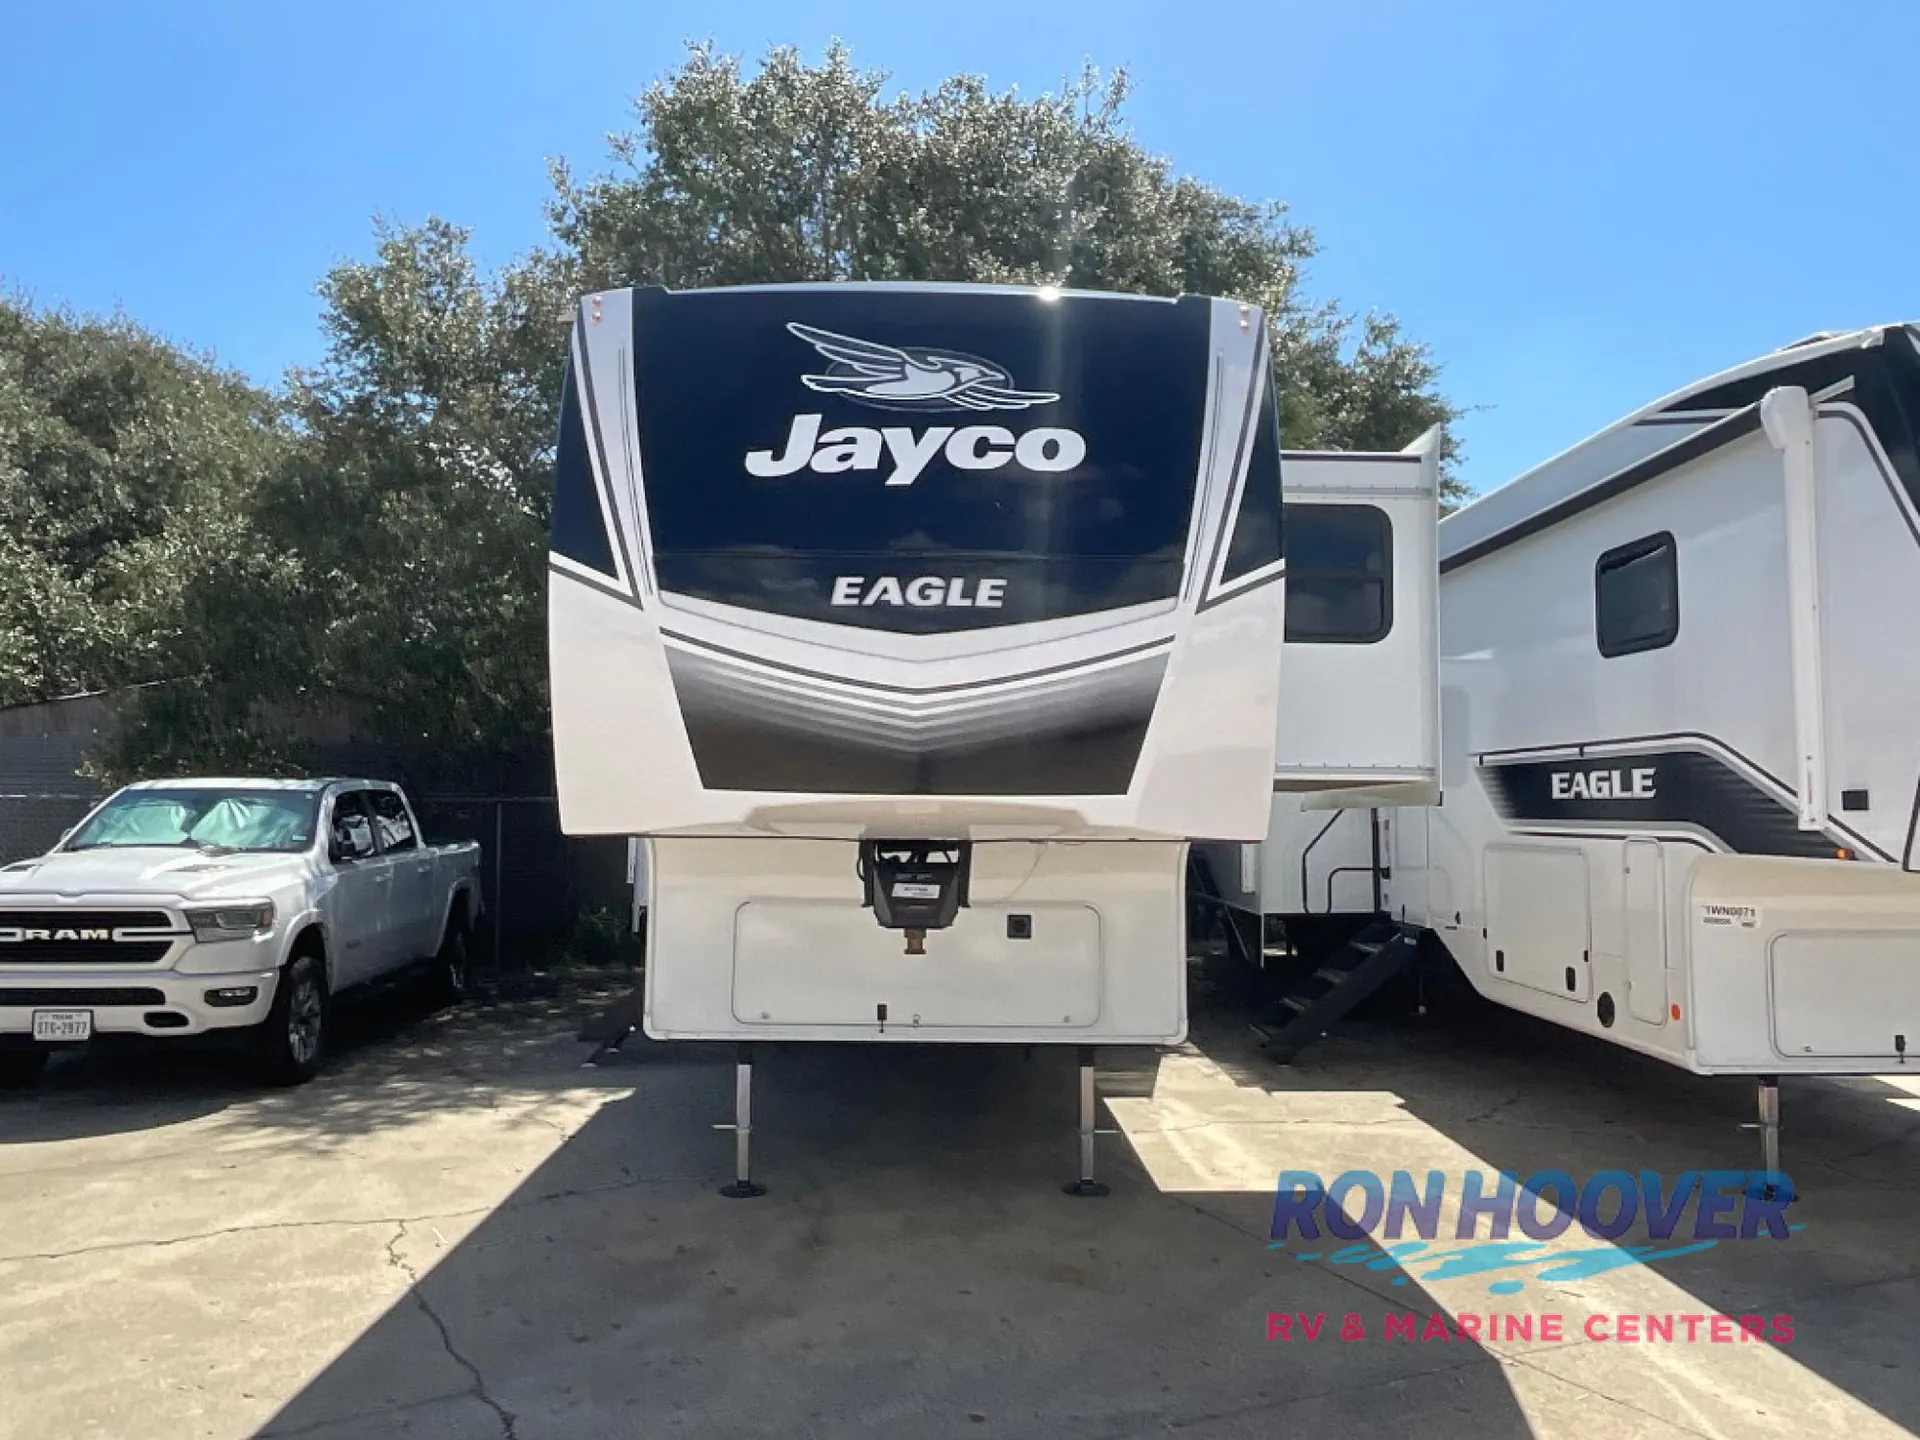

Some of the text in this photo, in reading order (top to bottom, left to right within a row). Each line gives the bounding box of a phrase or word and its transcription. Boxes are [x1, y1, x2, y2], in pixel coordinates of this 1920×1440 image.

[745, 413, 1087, 487] Jayco
[830, 576, 1008, 608] EAGLE
[1551, 767, 1657, 800] EAGLE
[25, 929, 108, 940] RAM
